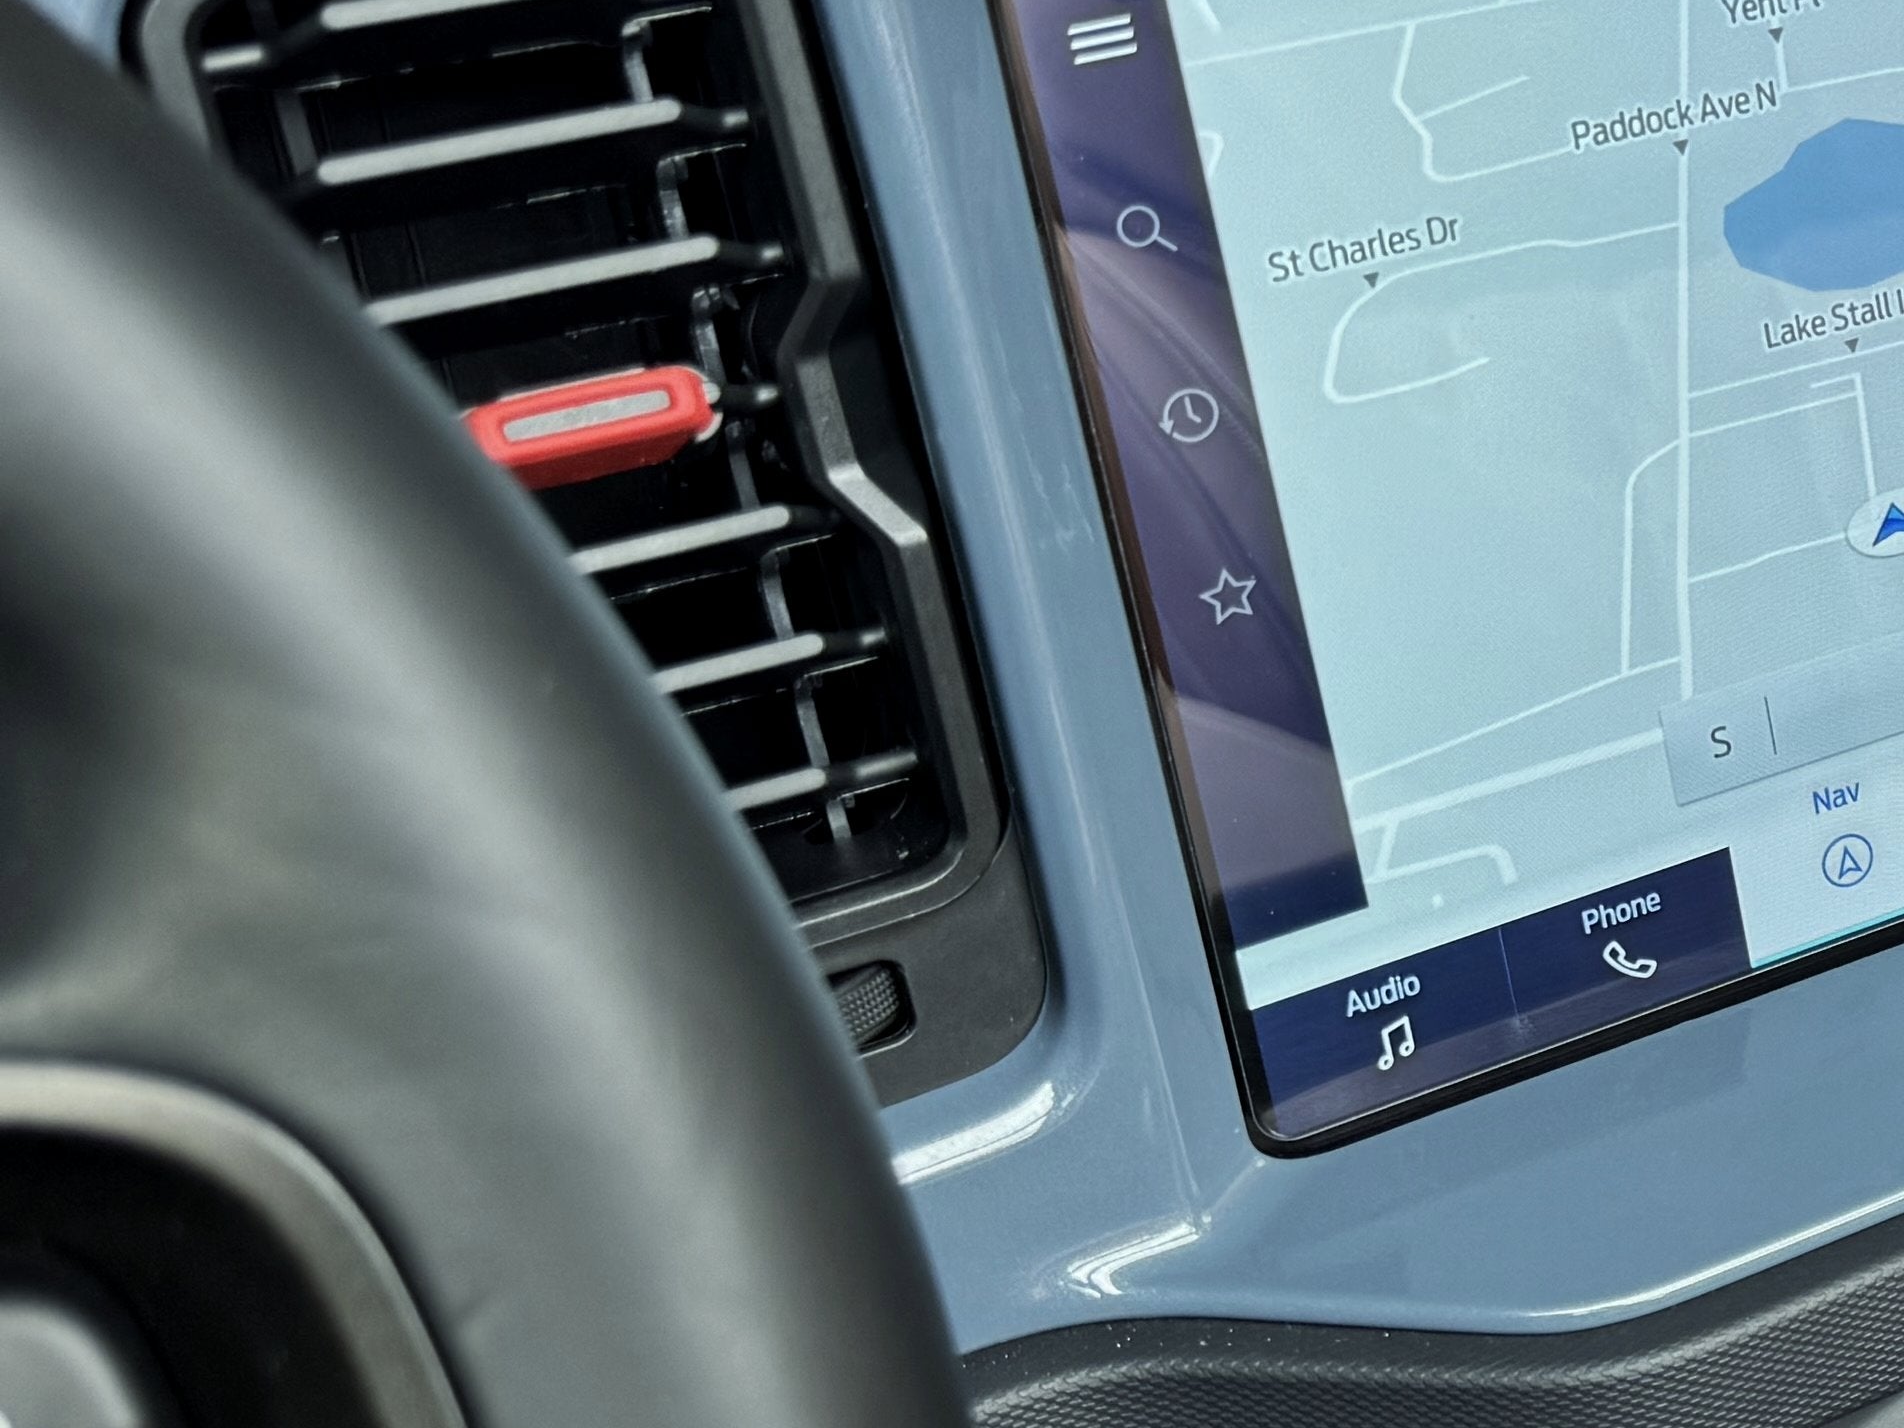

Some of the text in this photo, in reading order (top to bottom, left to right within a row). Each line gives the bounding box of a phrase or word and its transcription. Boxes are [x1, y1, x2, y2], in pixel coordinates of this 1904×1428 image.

[1571, 80, 1779, 151] Paddock Ave N
[1267, 213, 1461, 283] St Charles Dr
[1763, 316, 1827, 351] Lake
[1831, 291, 1892, 334] Stall
[1710, 725, 1733, 759] S
[1811, 781, 1861, 816] Nav
[1580, 888, 1662, 935] Phone
[1344, 973, 1422, 1018] Audio
